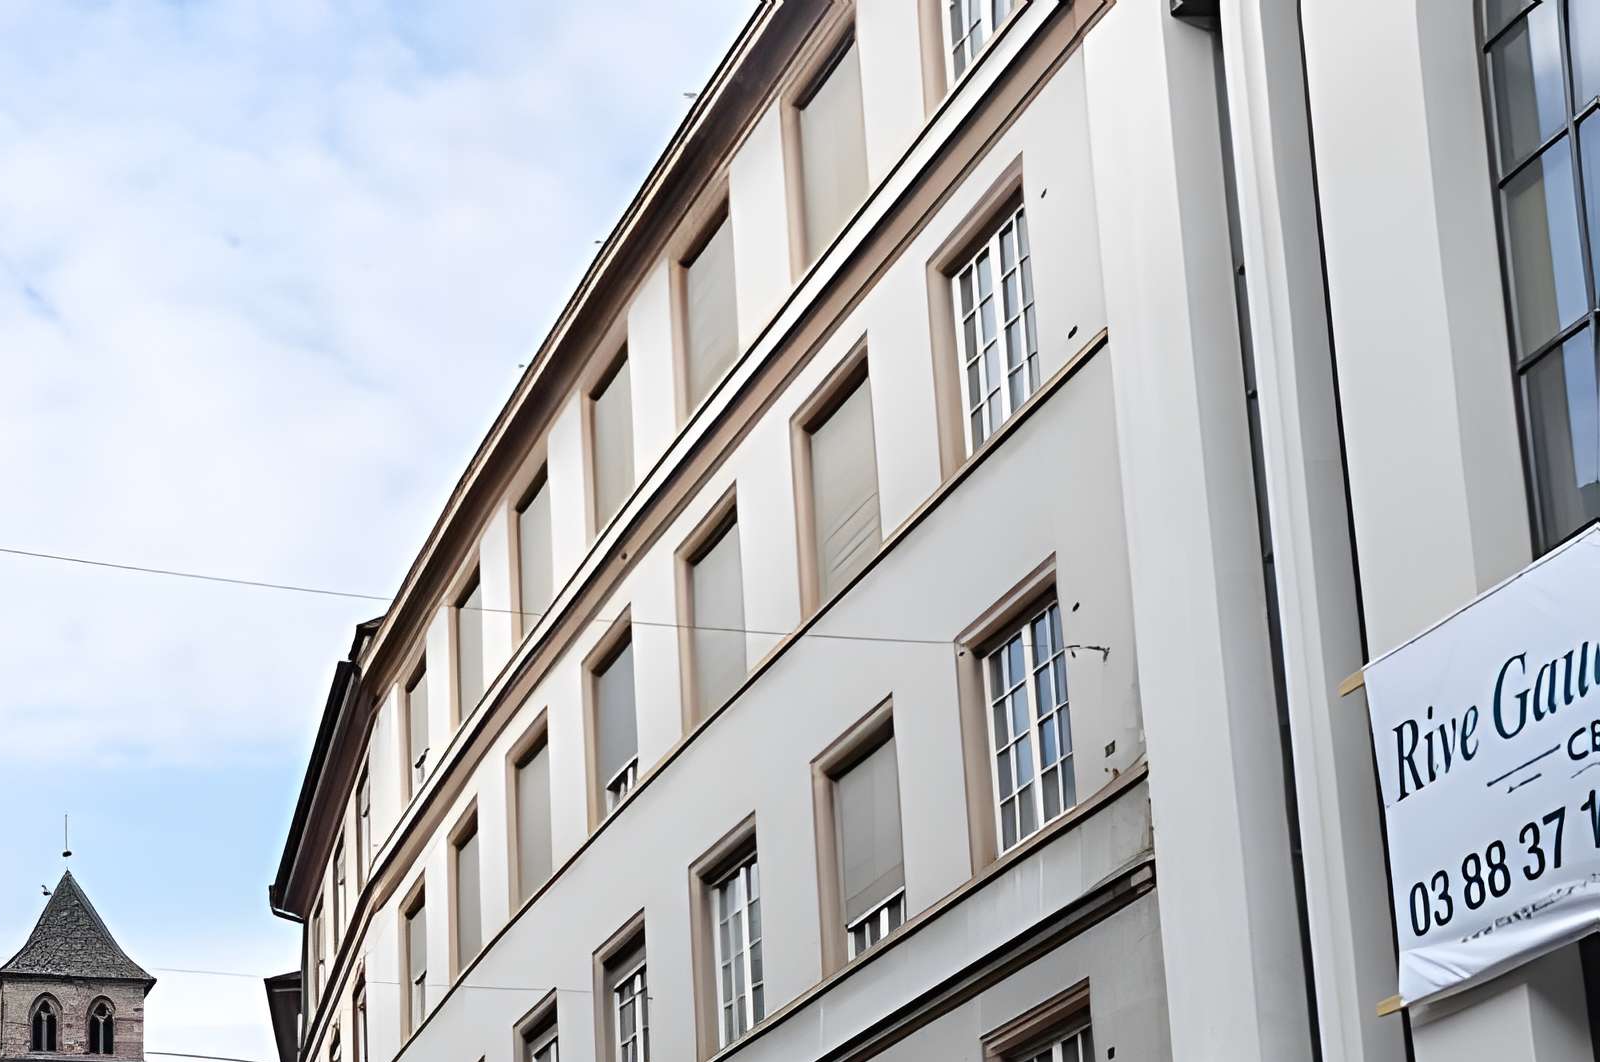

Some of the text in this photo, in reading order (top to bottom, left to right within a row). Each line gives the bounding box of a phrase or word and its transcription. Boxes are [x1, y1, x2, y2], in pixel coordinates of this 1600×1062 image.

[1393, 704, 1479, 802] Rive
[1409, 869, 1453, 937] 03
[1461, 839, 1512, 911] 88
[1519, 806, 1566, 881] 37
